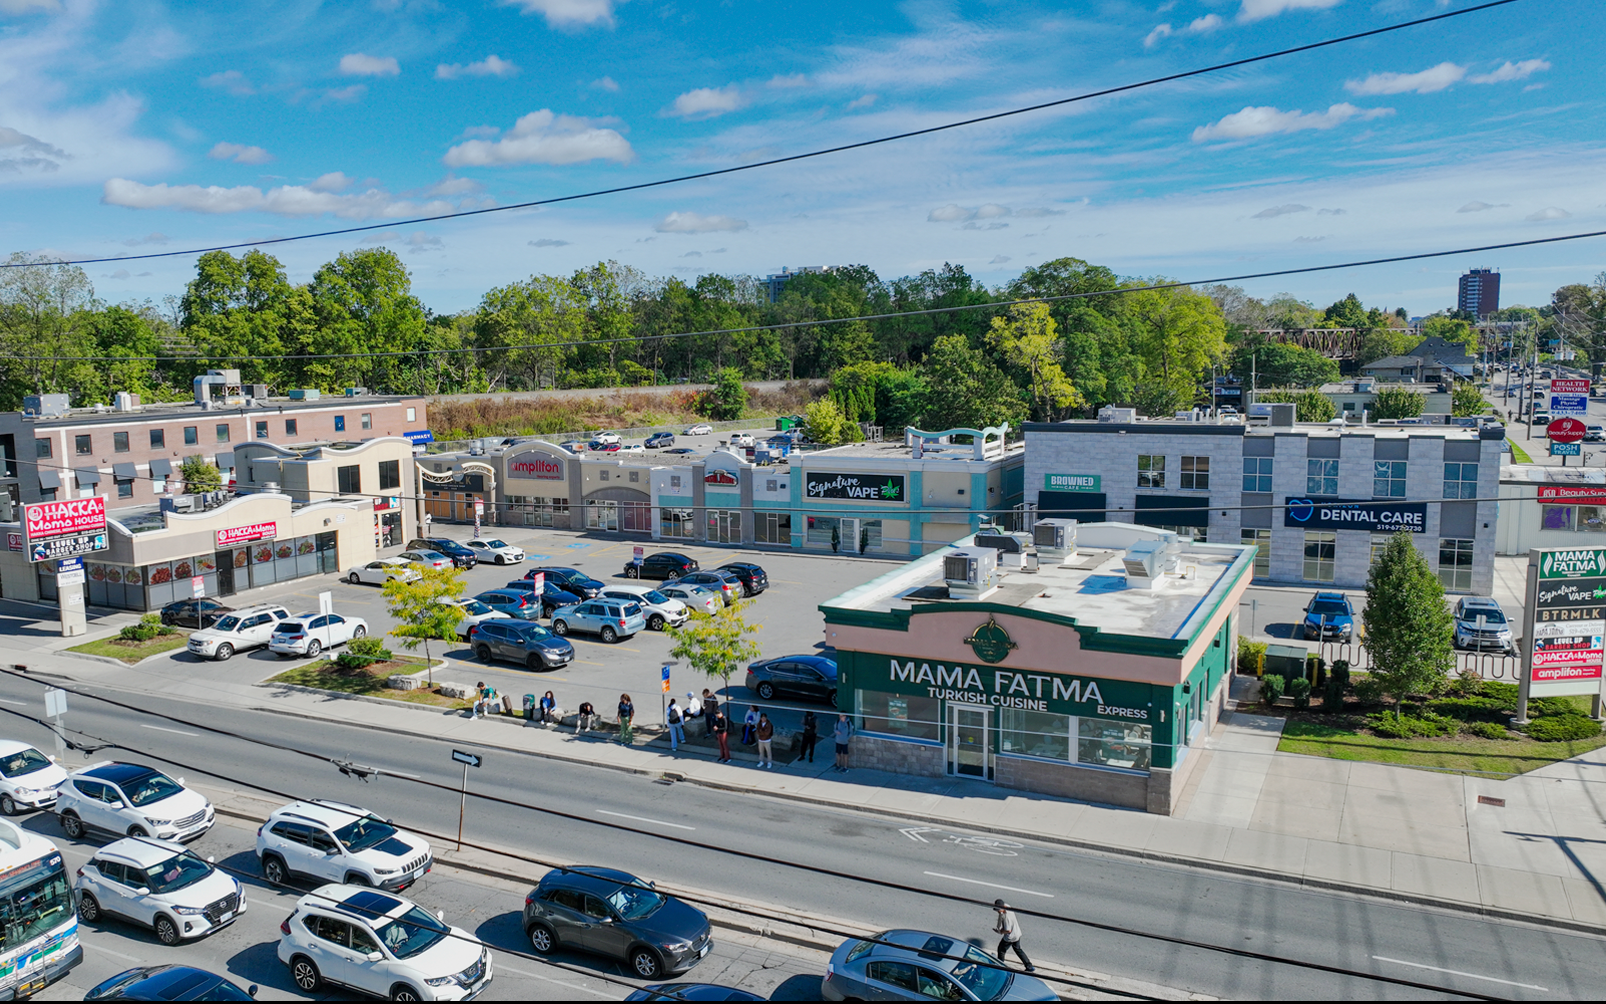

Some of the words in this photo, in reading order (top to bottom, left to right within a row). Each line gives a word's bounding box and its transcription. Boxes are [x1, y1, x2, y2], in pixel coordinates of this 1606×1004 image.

[511, 460, 559, 475] amplifon
[808, 475, 860, 497] Signature
[1051, 476, 1094, 486] BROWNED
[847, 487, 878, 498] VAPE
[44, 499, 98, 520] HAKKA
[1321, 509, 1378, 522] DENTAL
[1380, 512, 1422, 524] CARE
[29, 519, 72, 532] Momo
[75, 514, 104, 525] HOUSE
[228, 526, 253, 538] HAKKA
[46, 546, 74, 555] BARBER
[76, 542, 93, 550] SHOP
[50, 539, 76, 548] LEVEL
[1555, 550, 1595, 561] MAMA
[59, 564, 81, 572] LEASING
[1553, 560, 1596, 572] FATMA
[1539, 585, 1579, 603] Signature
[1568, 592, 1592, 600] VAPE
[1542, 609, 1600, 621] BTRMLK
[1543, 652, 1574, 661] HAKKA
[1578, 651, 1603, 660] Momo
[1538, 667, 1582, 679] amplifon
[890, 659, 984, 691] MAMA
[995, 670, 1104, 705] FATMA
[927, 687, 987, 705] TURKISH
[990, 694, 1048, 712] CUISINE
[1097, 704, 1148, 719] EXPRESS
[49, 856, 61, 866] 570
[16, 946, 26, 956] 570
